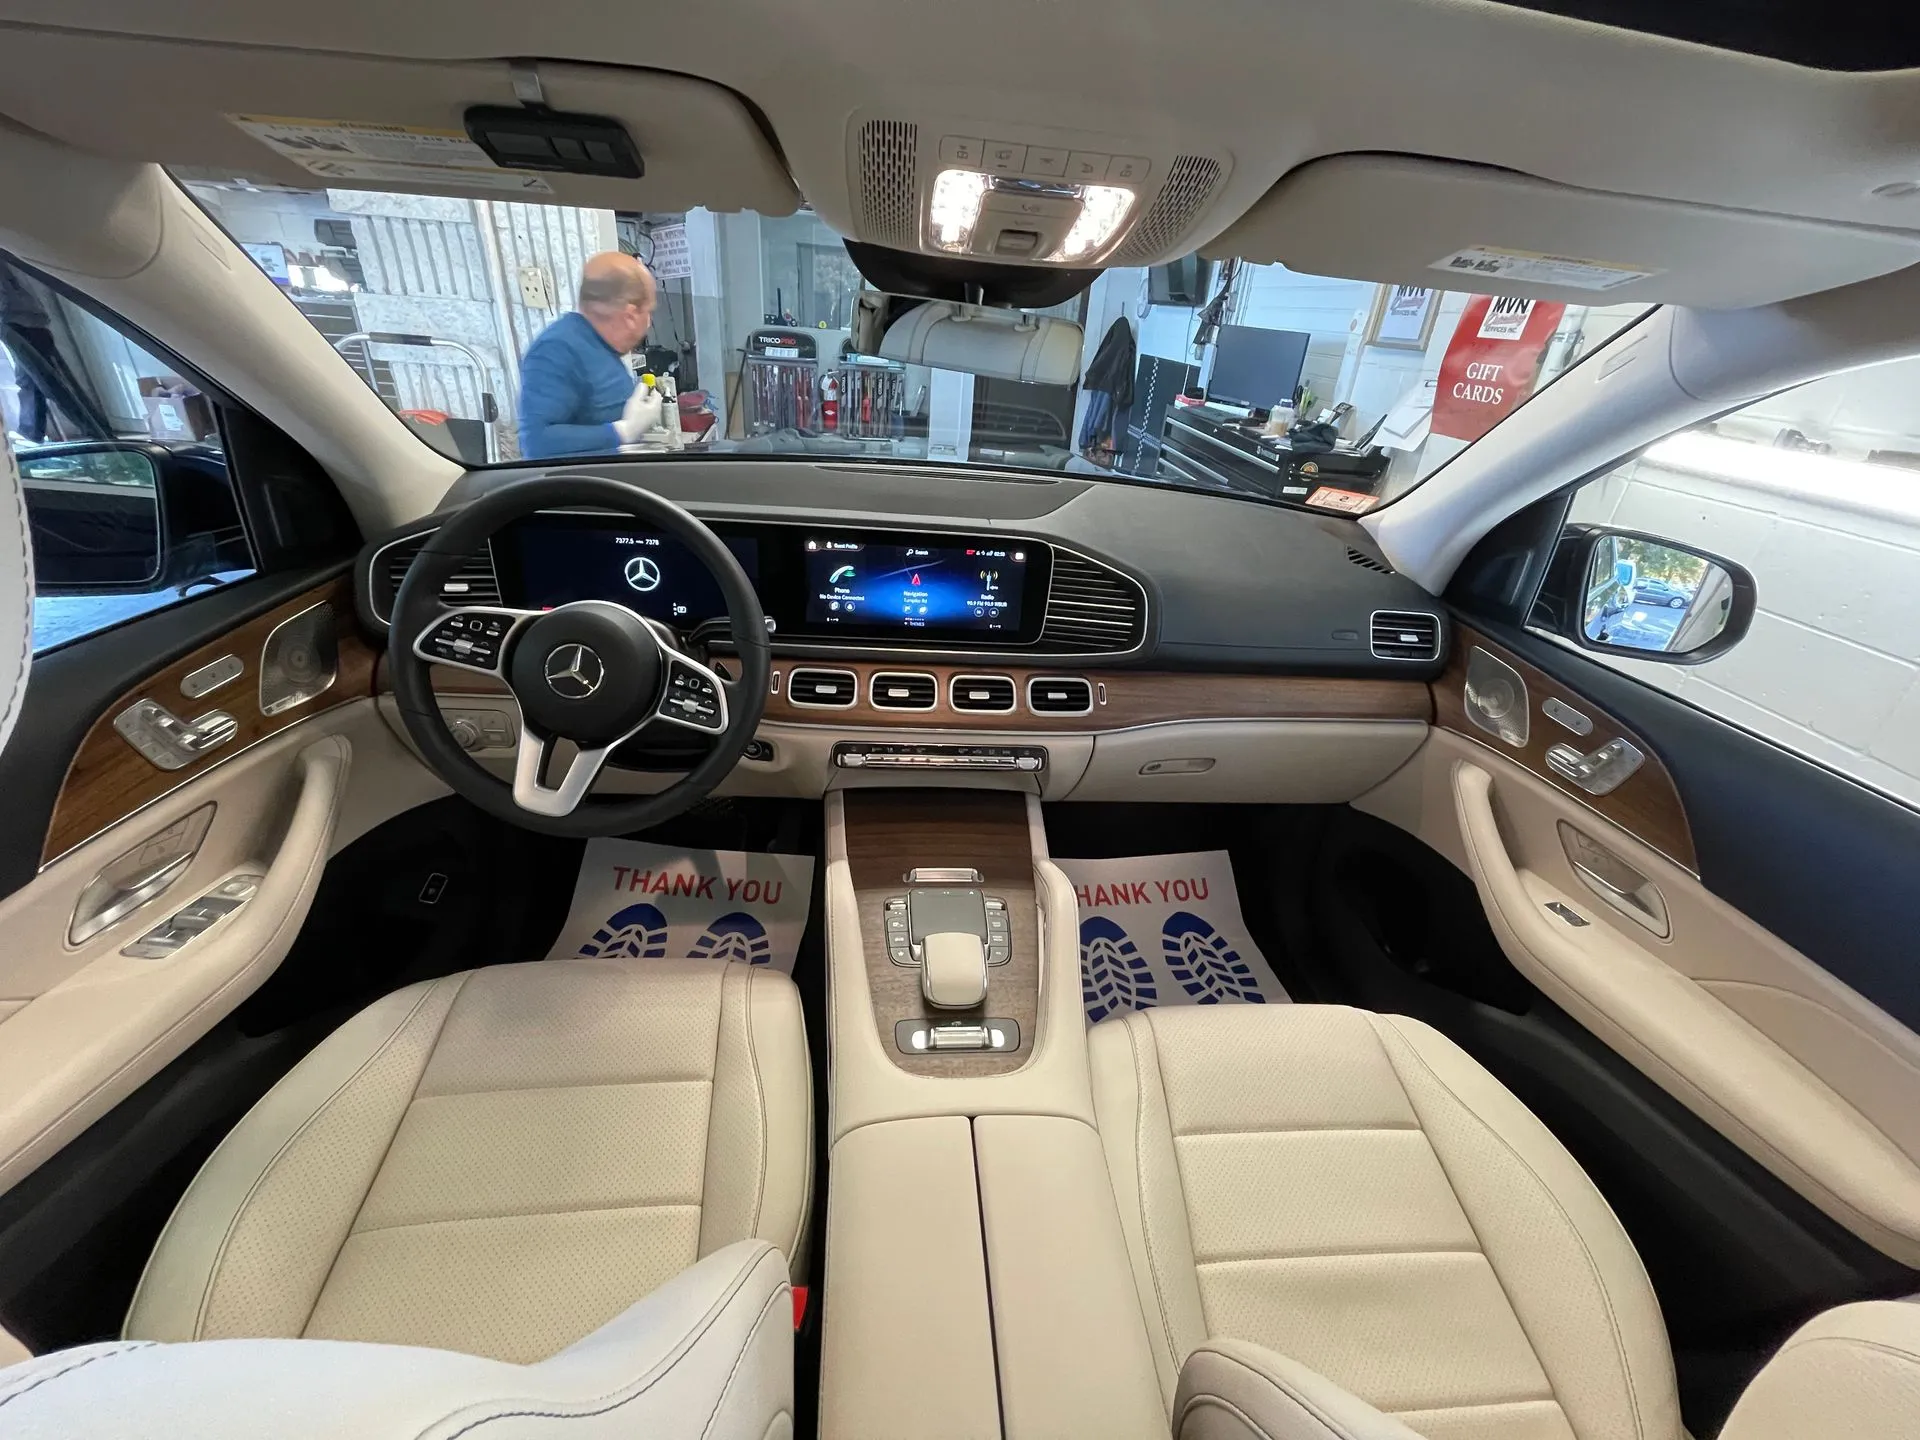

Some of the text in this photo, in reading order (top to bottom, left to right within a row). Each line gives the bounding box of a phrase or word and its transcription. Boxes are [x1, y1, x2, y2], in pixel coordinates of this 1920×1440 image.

[1492, 296, 1531, 314] MVN
[1466, 362, 1504, 382] GIFT
[1453, 382, 1504, 405] CARDS
[613, 865, 783, 905] THANK YOU
[1074, 877, 1210, 908] HANK YOU
